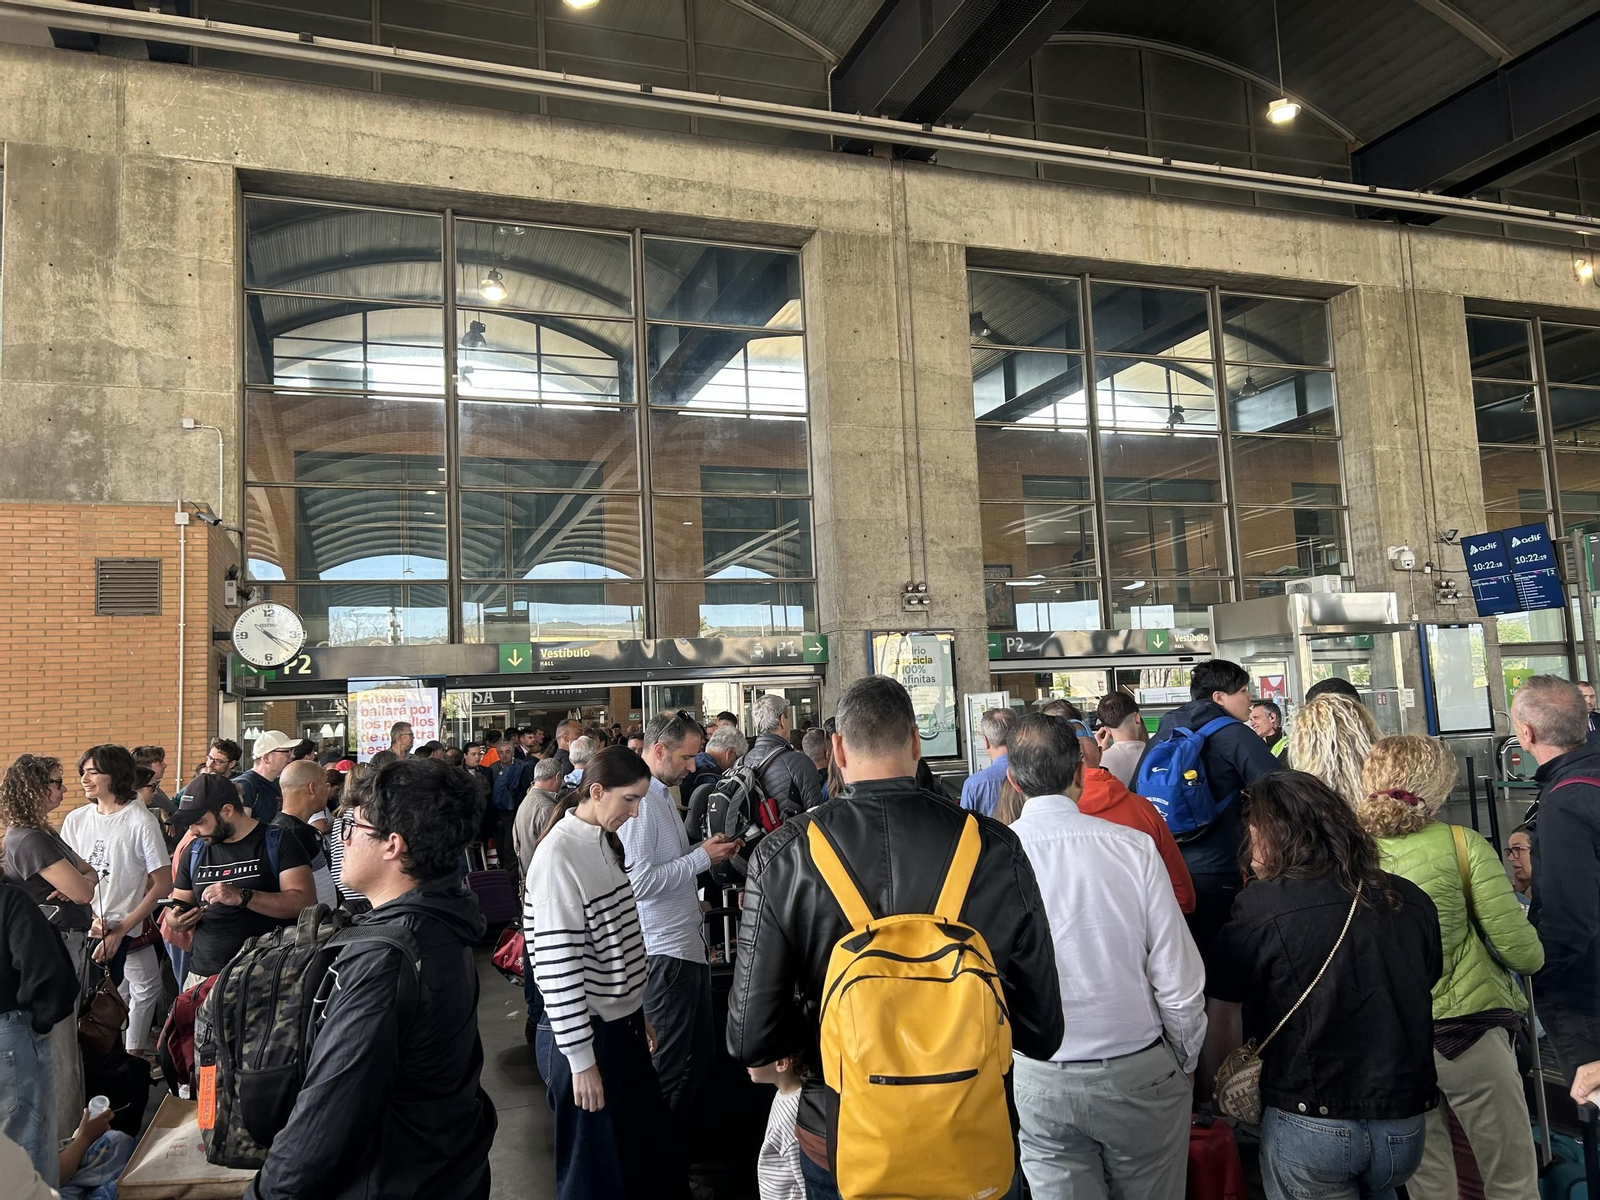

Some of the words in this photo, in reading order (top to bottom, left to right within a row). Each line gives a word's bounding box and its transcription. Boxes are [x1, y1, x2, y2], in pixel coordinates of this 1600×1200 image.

[1521, 533, 1542, 544] adif
[1478, 542, 1498, 552] adif
[262, 609, 275, 618] 12
[240, 631, 248, 640] 9
[289, 630, 297, 639] 3
[1174, 633, 1209, 643] Vestíbulo
[776, 640, 798, 657] P1
[901, 645, 927, 655] drio
[1005, 636, 1025, 653] P2
[264, 653, 273, 661] 6
[540, 646, 590, 658] Vestíbulo
[283, 654, 312, 675] P2
[901, 674, 936, 684] nfinitas
[361, 704, 406, 717] bailará
[410, 705, 433, 718] por
[361, 718, 381, 730] los
[361, 732, 378, 743] de
[382, 730, 435, 742] ntra
[197, 870, 220, 879] JACK
[233, 864, 258, 875] JONES
